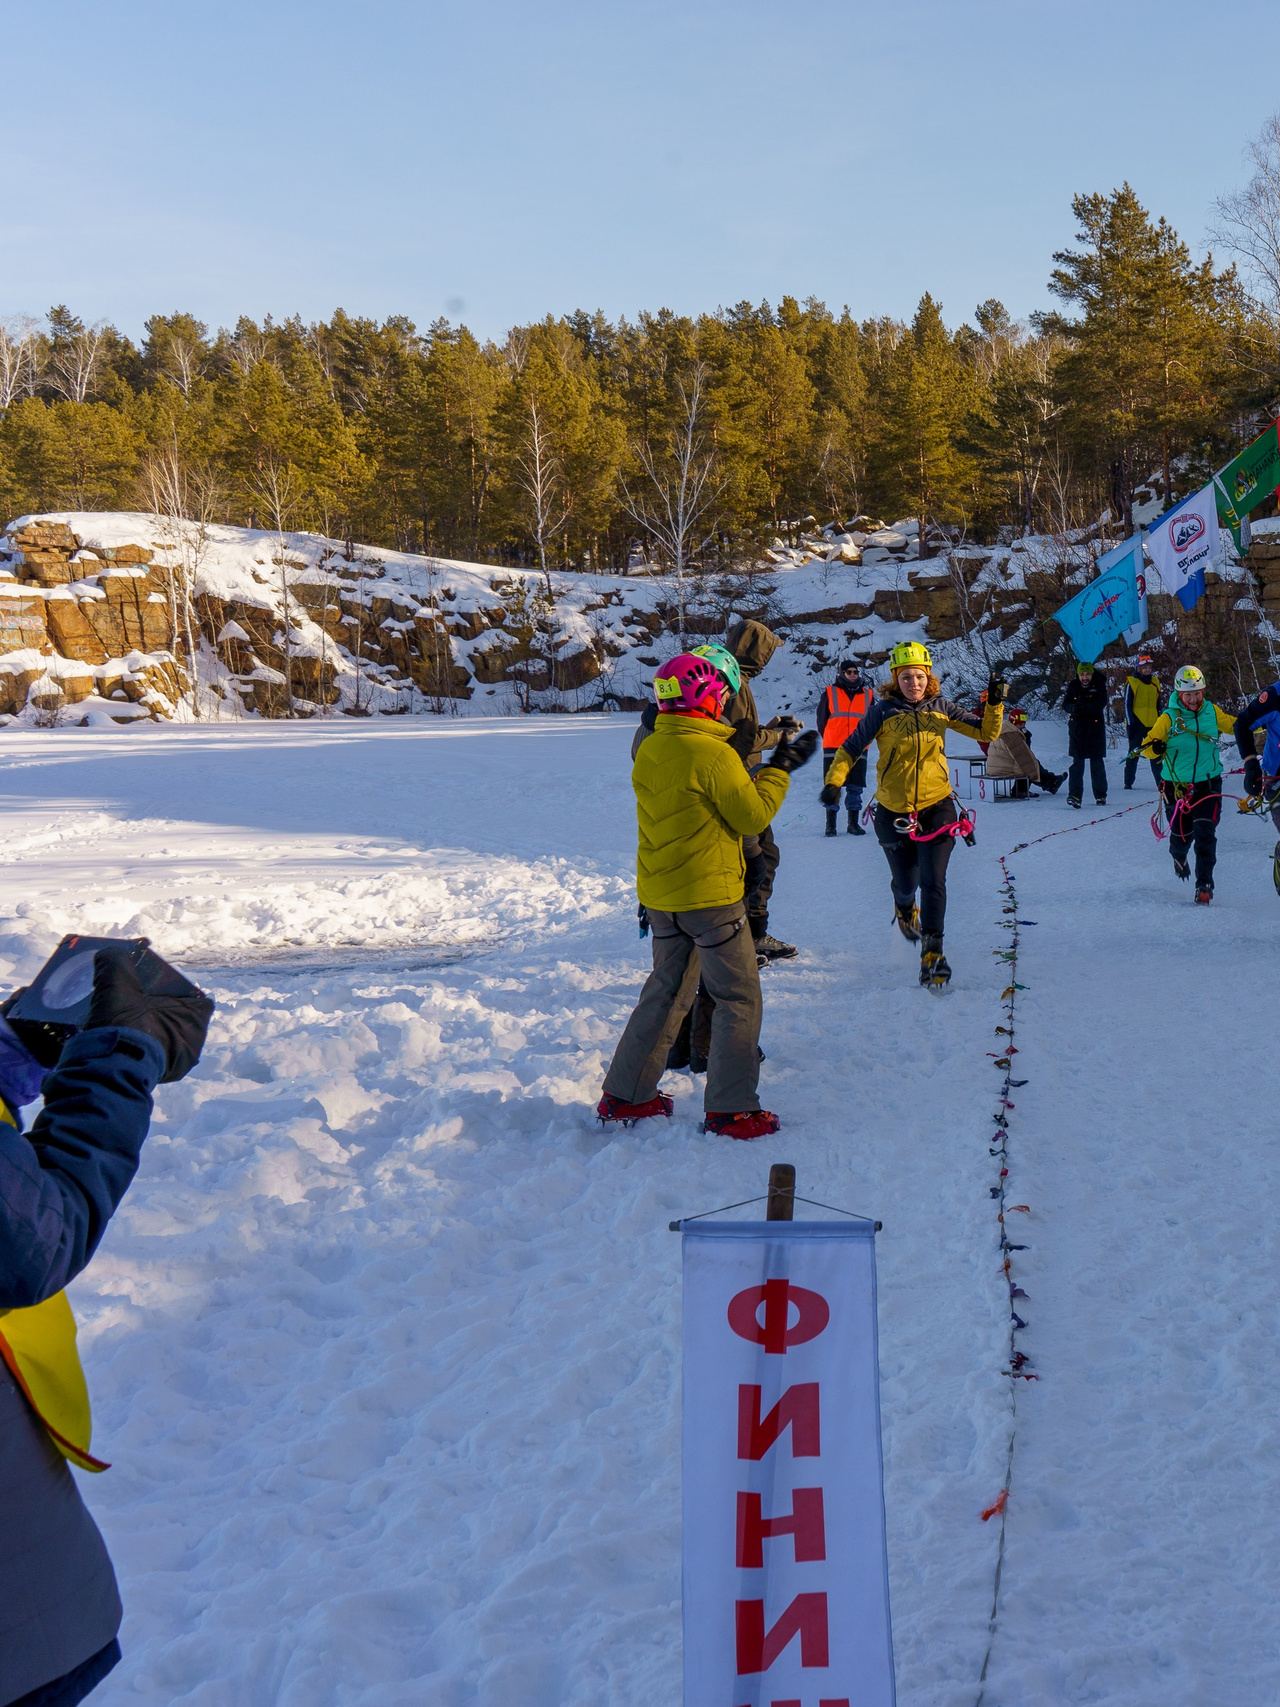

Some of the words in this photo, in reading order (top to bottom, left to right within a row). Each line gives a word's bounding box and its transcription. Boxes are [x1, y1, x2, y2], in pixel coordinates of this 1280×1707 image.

[659, 683, 673, 693] 8.1
[955, 769, 959, 788] 1
[979, 779, 986, 800] 3
[727, 1278, 850, 1707] ФИНИ
